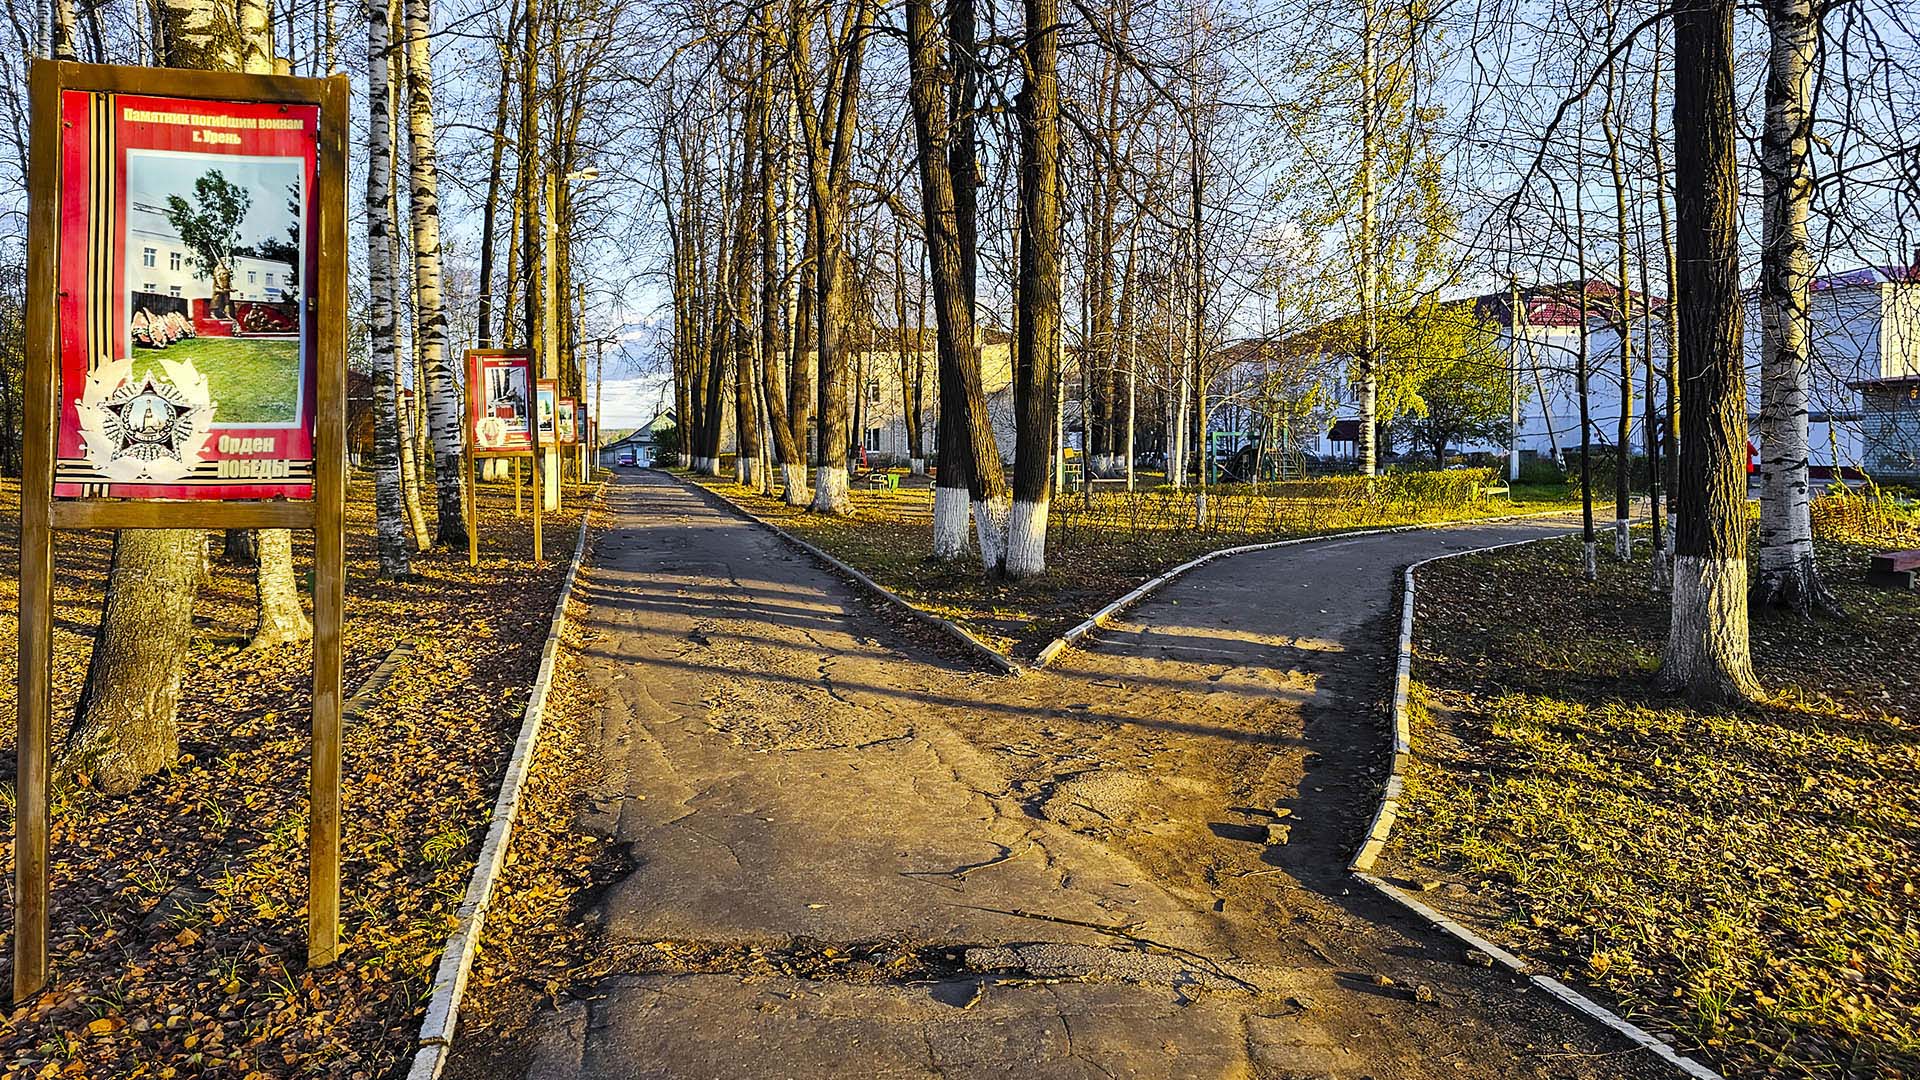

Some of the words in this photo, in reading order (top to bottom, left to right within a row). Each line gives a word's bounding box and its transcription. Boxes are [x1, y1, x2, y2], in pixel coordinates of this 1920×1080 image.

[123, 107, 190, 125] Памятник
[191, 114, 257, 129] погибшим
[258, 118, 304, 130] воинам
[203, 130, 242, 145] Урень
[218, 434, 275, 455] Орден
[217, 459, 290, 480] ПОБЕДЫ
